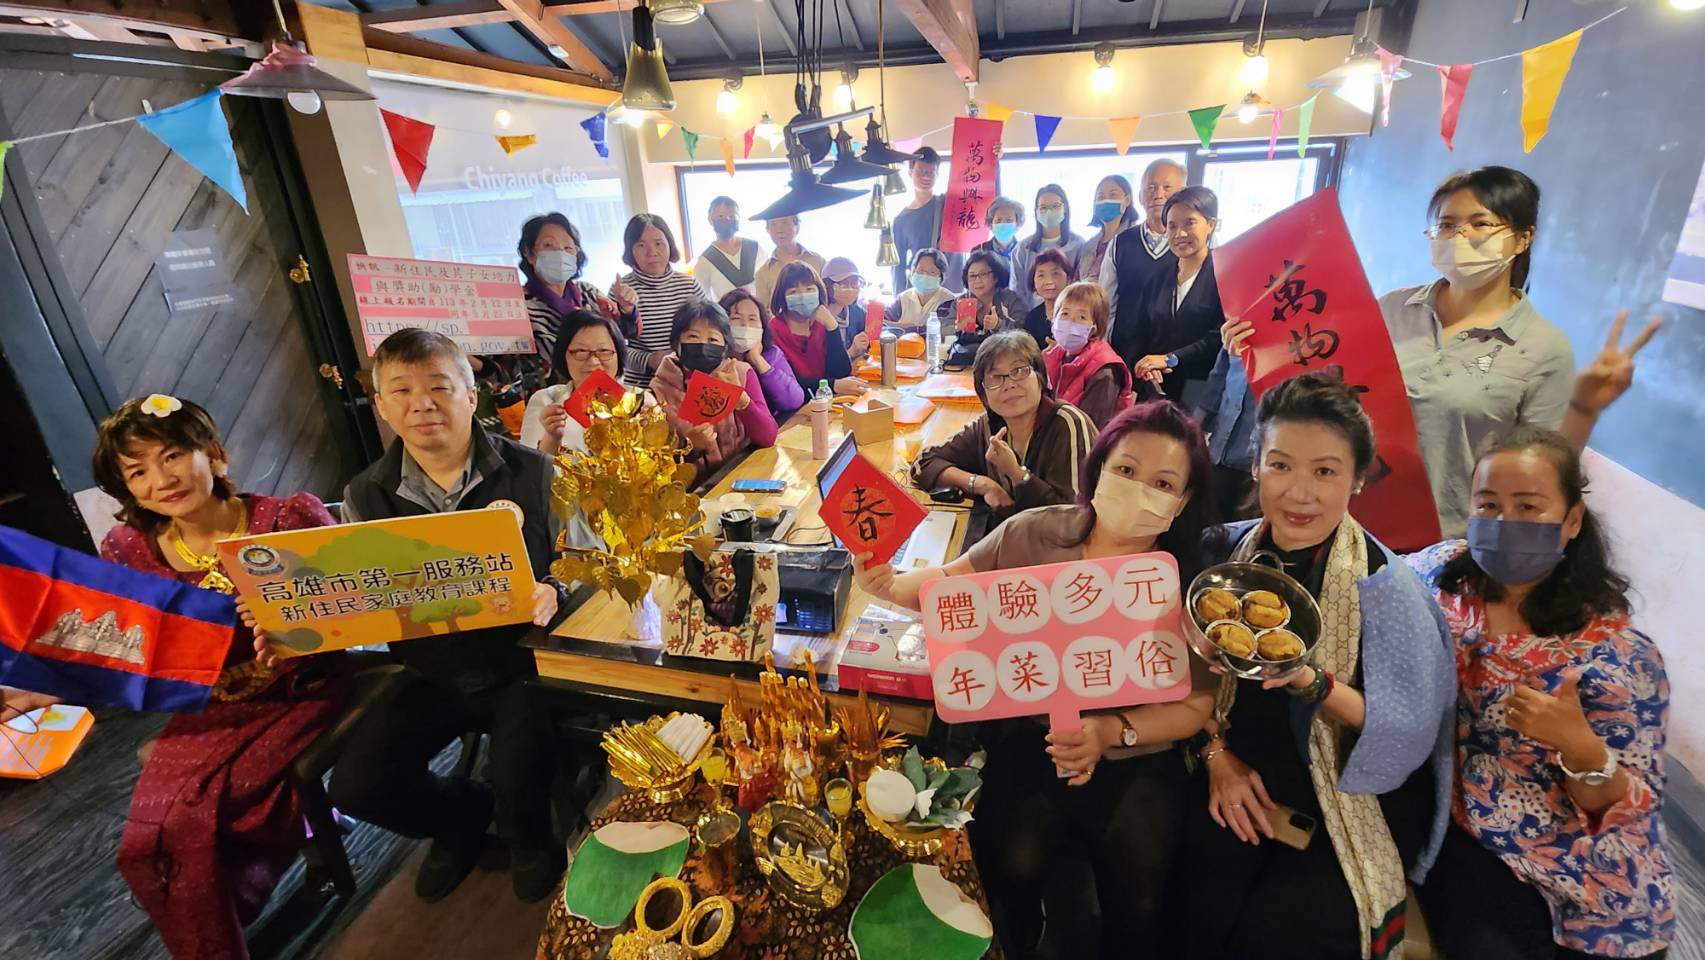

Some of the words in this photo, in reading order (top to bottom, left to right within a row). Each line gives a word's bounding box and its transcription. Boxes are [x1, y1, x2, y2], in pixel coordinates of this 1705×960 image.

[543, 166, 588, 188] Coffee
[842, 483, 895, 541] 春
[256, 552, 514, 602] 高雄市第一服務站
[280, 577, 513, 622] 新住民家庭教育課程
[936, 566, 1167, 634] 體驗多元
[947, 638, 1178, 705] 年菜習俗
